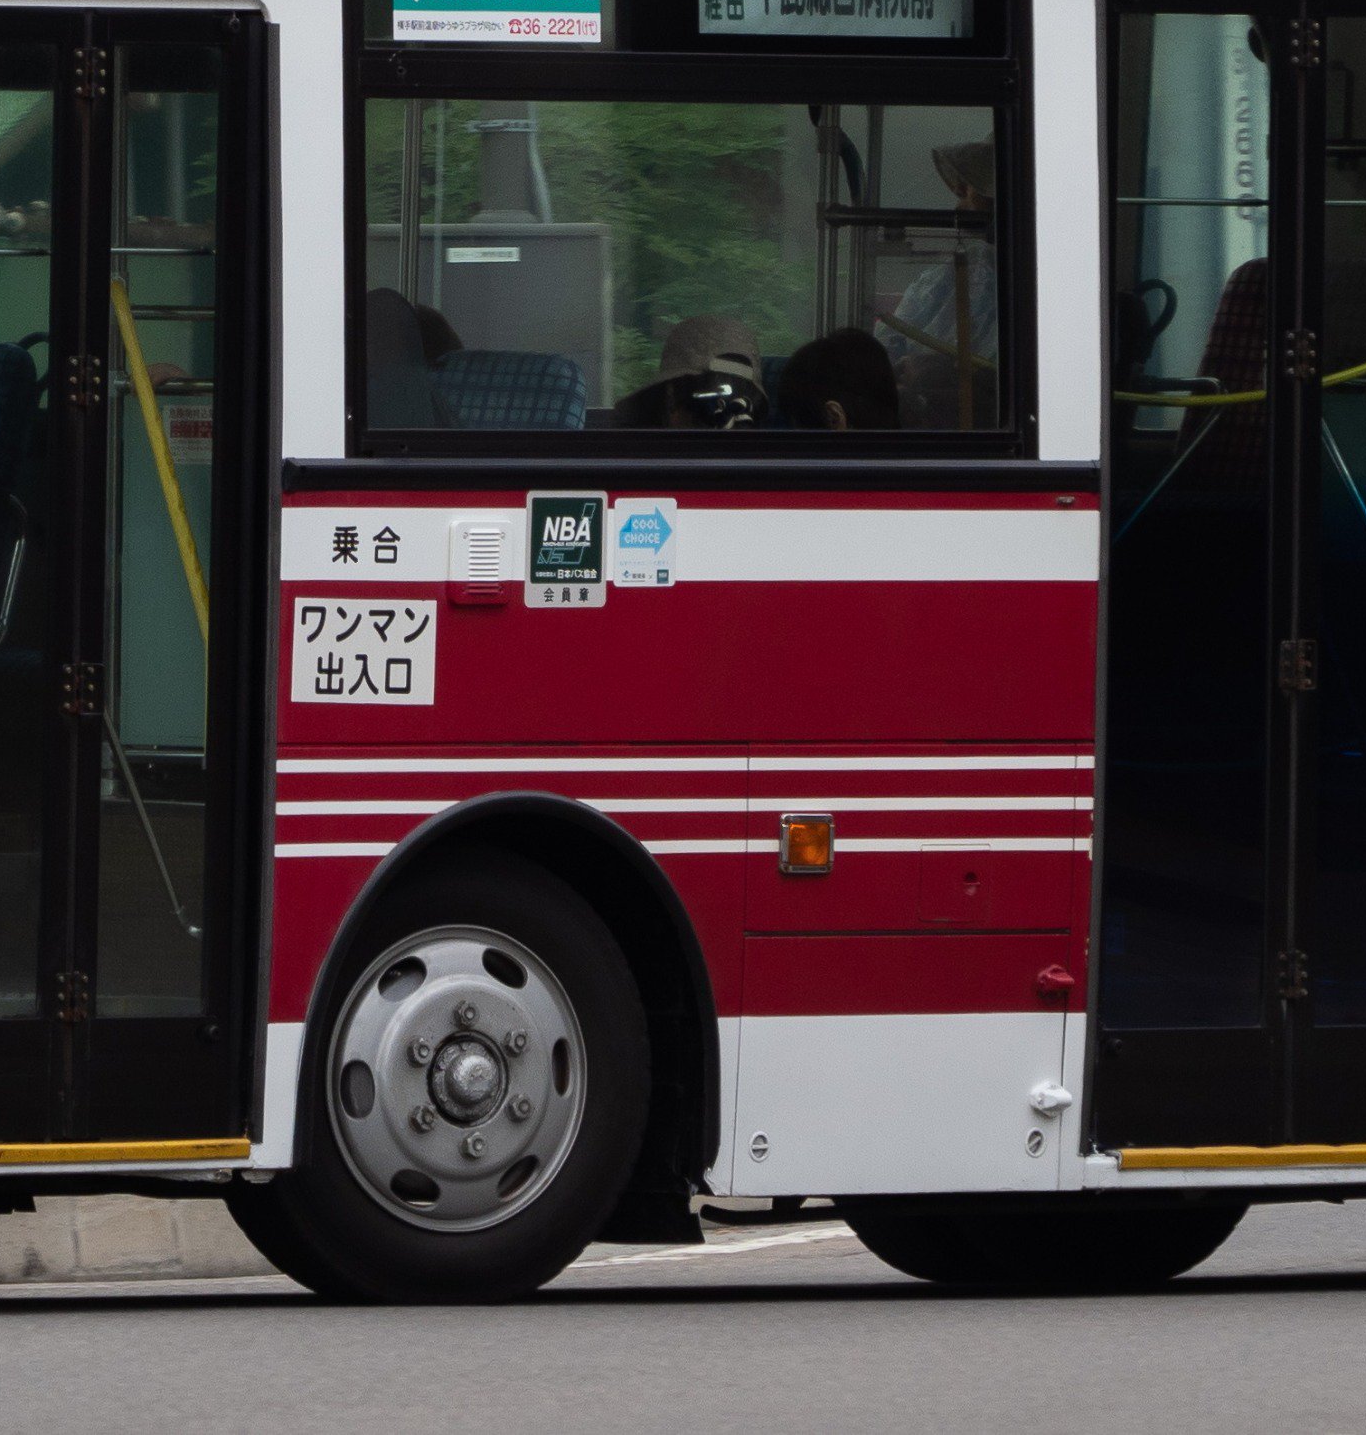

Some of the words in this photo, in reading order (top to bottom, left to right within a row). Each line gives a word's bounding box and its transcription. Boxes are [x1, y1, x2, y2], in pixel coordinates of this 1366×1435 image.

[543, 516, 592, 542] NBA
[632, 518, 661, 531] COOL
[332, 525, 401, 564] 乗合
[624, 532, 661, 545] CHOICE
[544, 587, 591, 604] 会員章
[301, 605, 430, 644] ワンマン
[315, 652, 413, 696] 出入口
